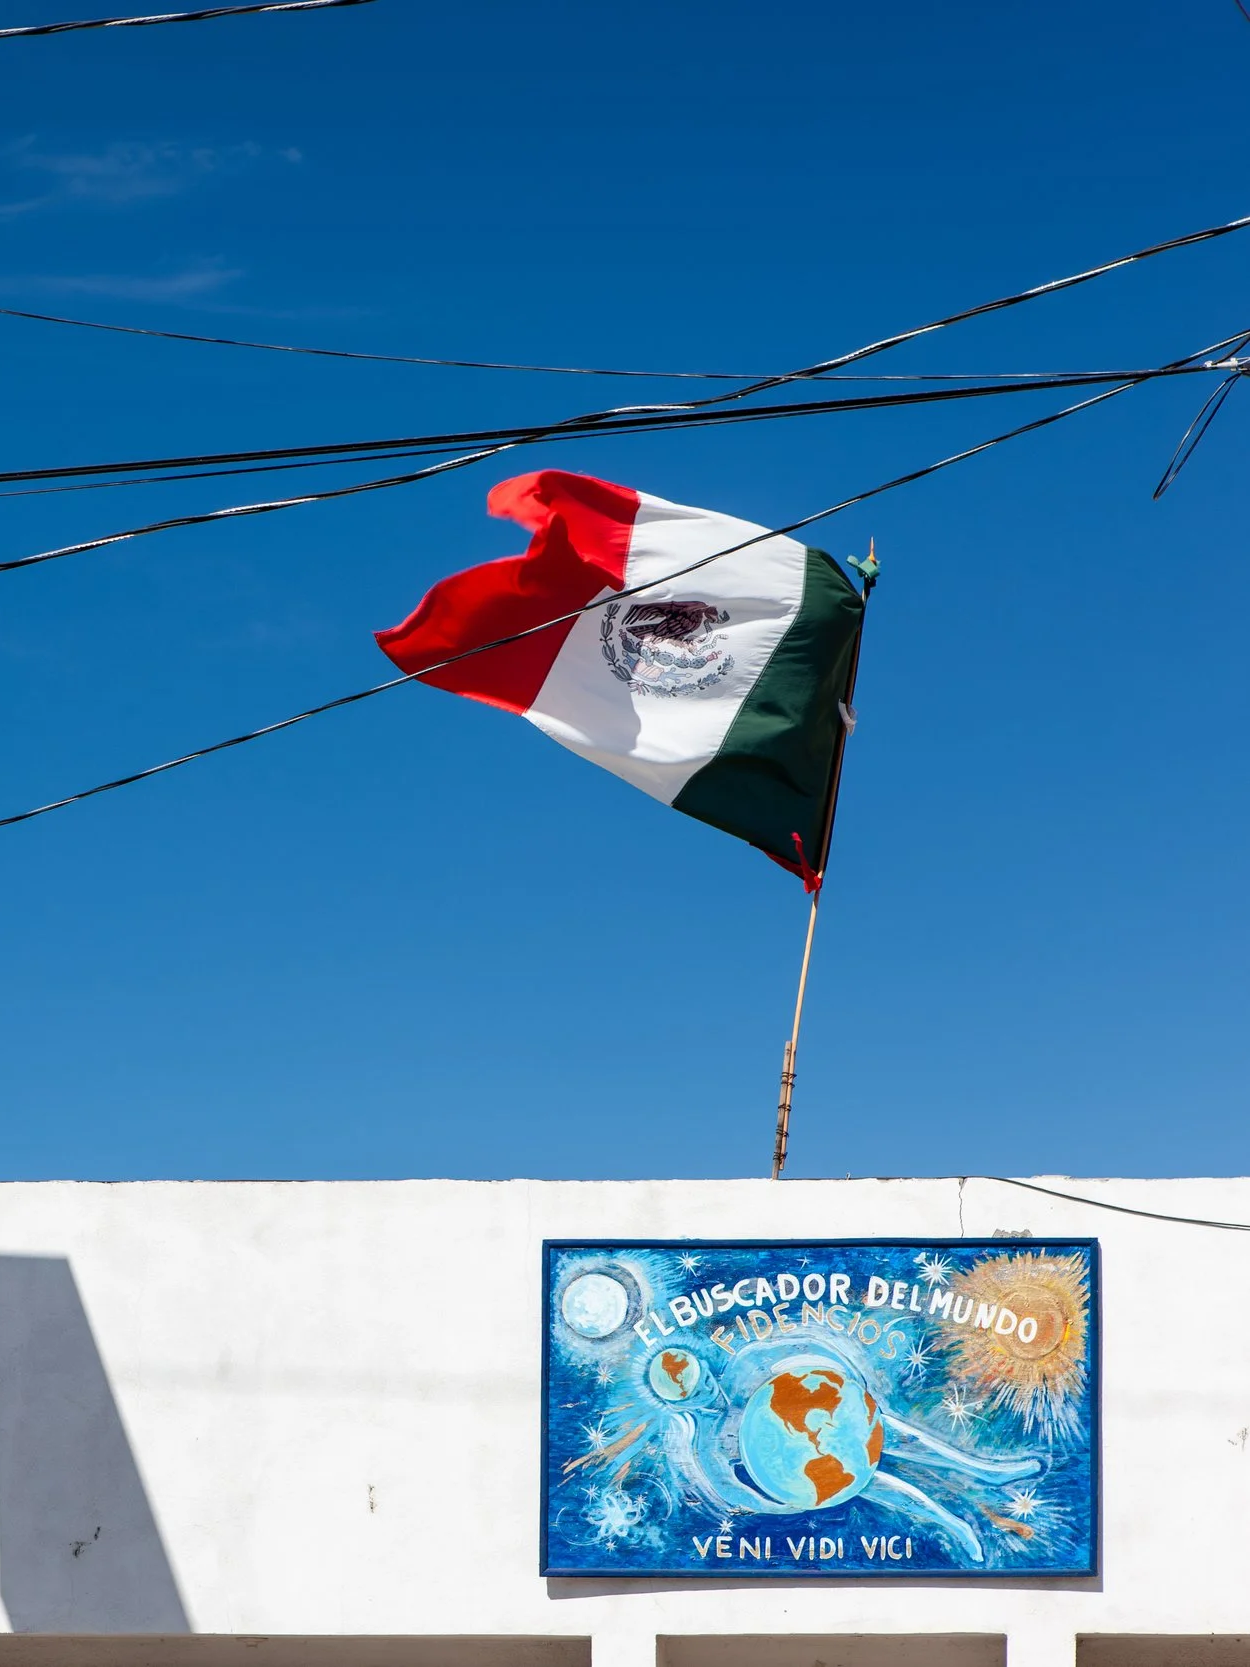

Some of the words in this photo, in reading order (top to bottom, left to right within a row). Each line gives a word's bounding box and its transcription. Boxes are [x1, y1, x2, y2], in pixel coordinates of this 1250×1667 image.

[634, 1311, 676, 1349] EL
[669, 1273, 851, 1328] BUSCADOR
[865, 1275, 922, 1313] DEL
[929, 1288, 1039, 1344] MUNDO
[709, 1300, 907, 1360] FIDENCIO'S
[692, 1535, 771, 1561] VENI
[786, 1535, 844, 1561] VIDI
[860, 1535, 912, 1560] VICI
